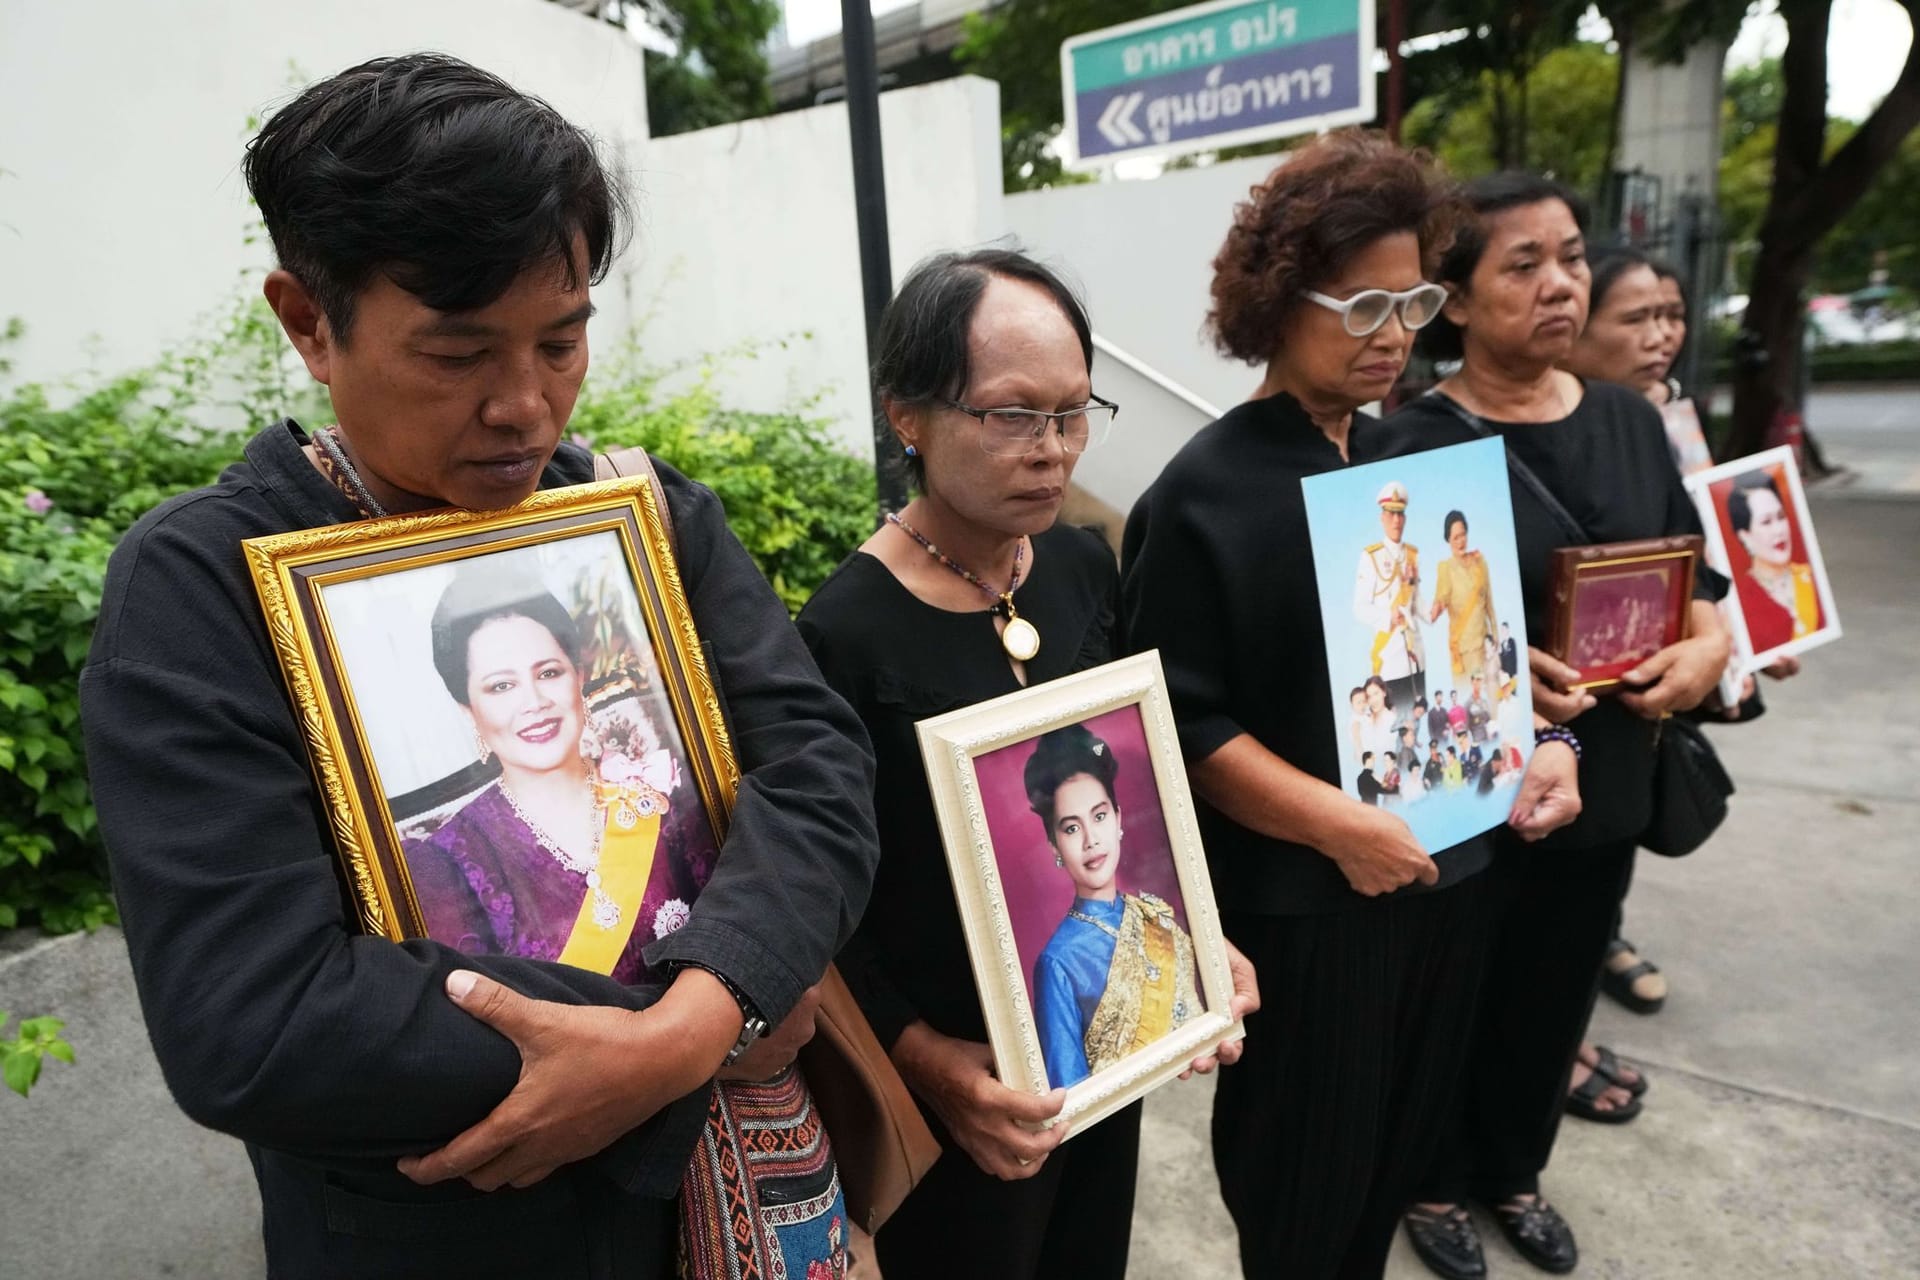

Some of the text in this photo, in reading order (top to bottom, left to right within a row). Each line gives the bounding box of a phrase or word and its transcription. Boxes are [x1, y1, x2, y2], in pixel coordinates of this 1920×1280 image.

[1123, 5, 1297, 74] อาคาร อปร
[1147, 64, 1333, 143] ศูนย์อาหาร
